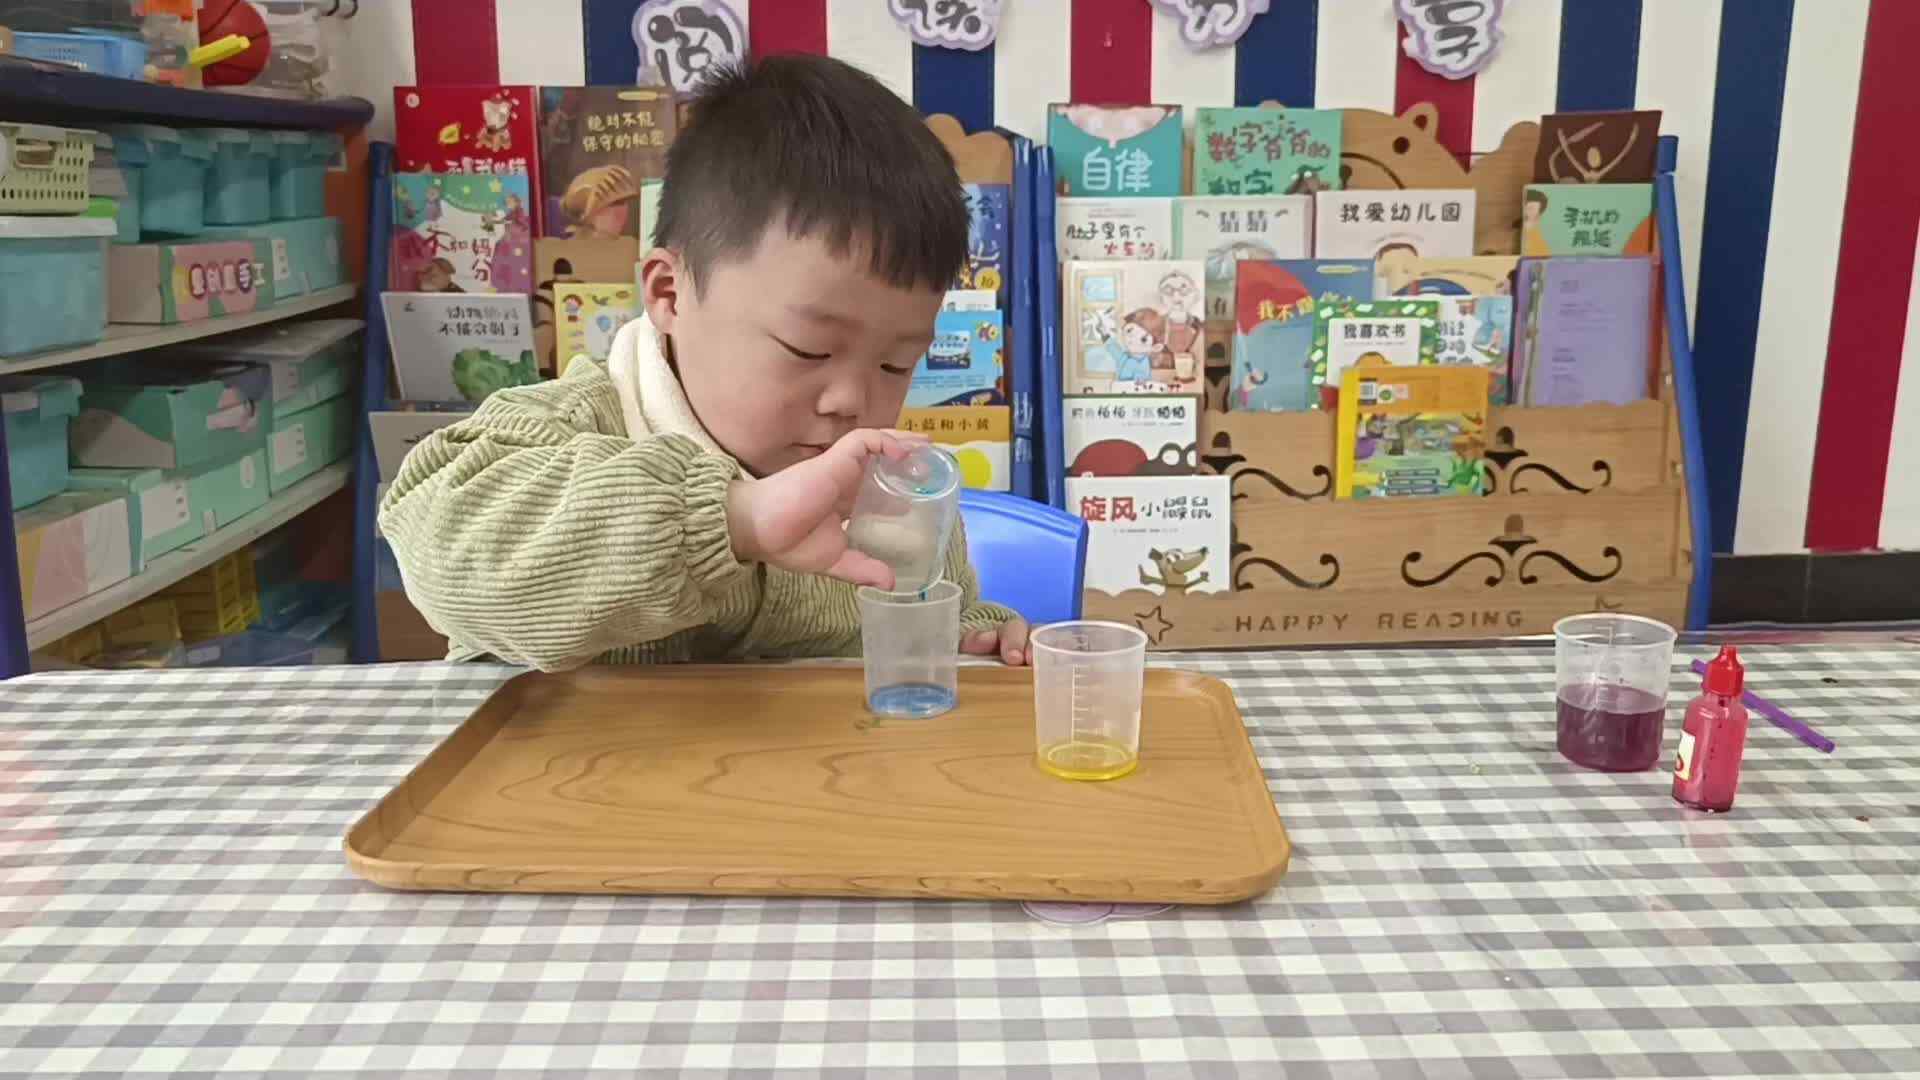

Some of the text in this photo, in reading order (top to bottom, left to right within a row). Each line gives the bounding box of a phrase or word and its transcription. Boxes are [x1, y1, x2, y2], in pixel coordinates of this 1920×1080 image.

[587, 112, 655, 132] 绝对不能
[1082, 147, 1152, 193] 自律
[1340, 201, 1461, 223] 我爱幼儿园
[1080, 496, 1212, 521] 旋风小鼹鼠
[1235, 610, 1523, 632] HAPPY READING
